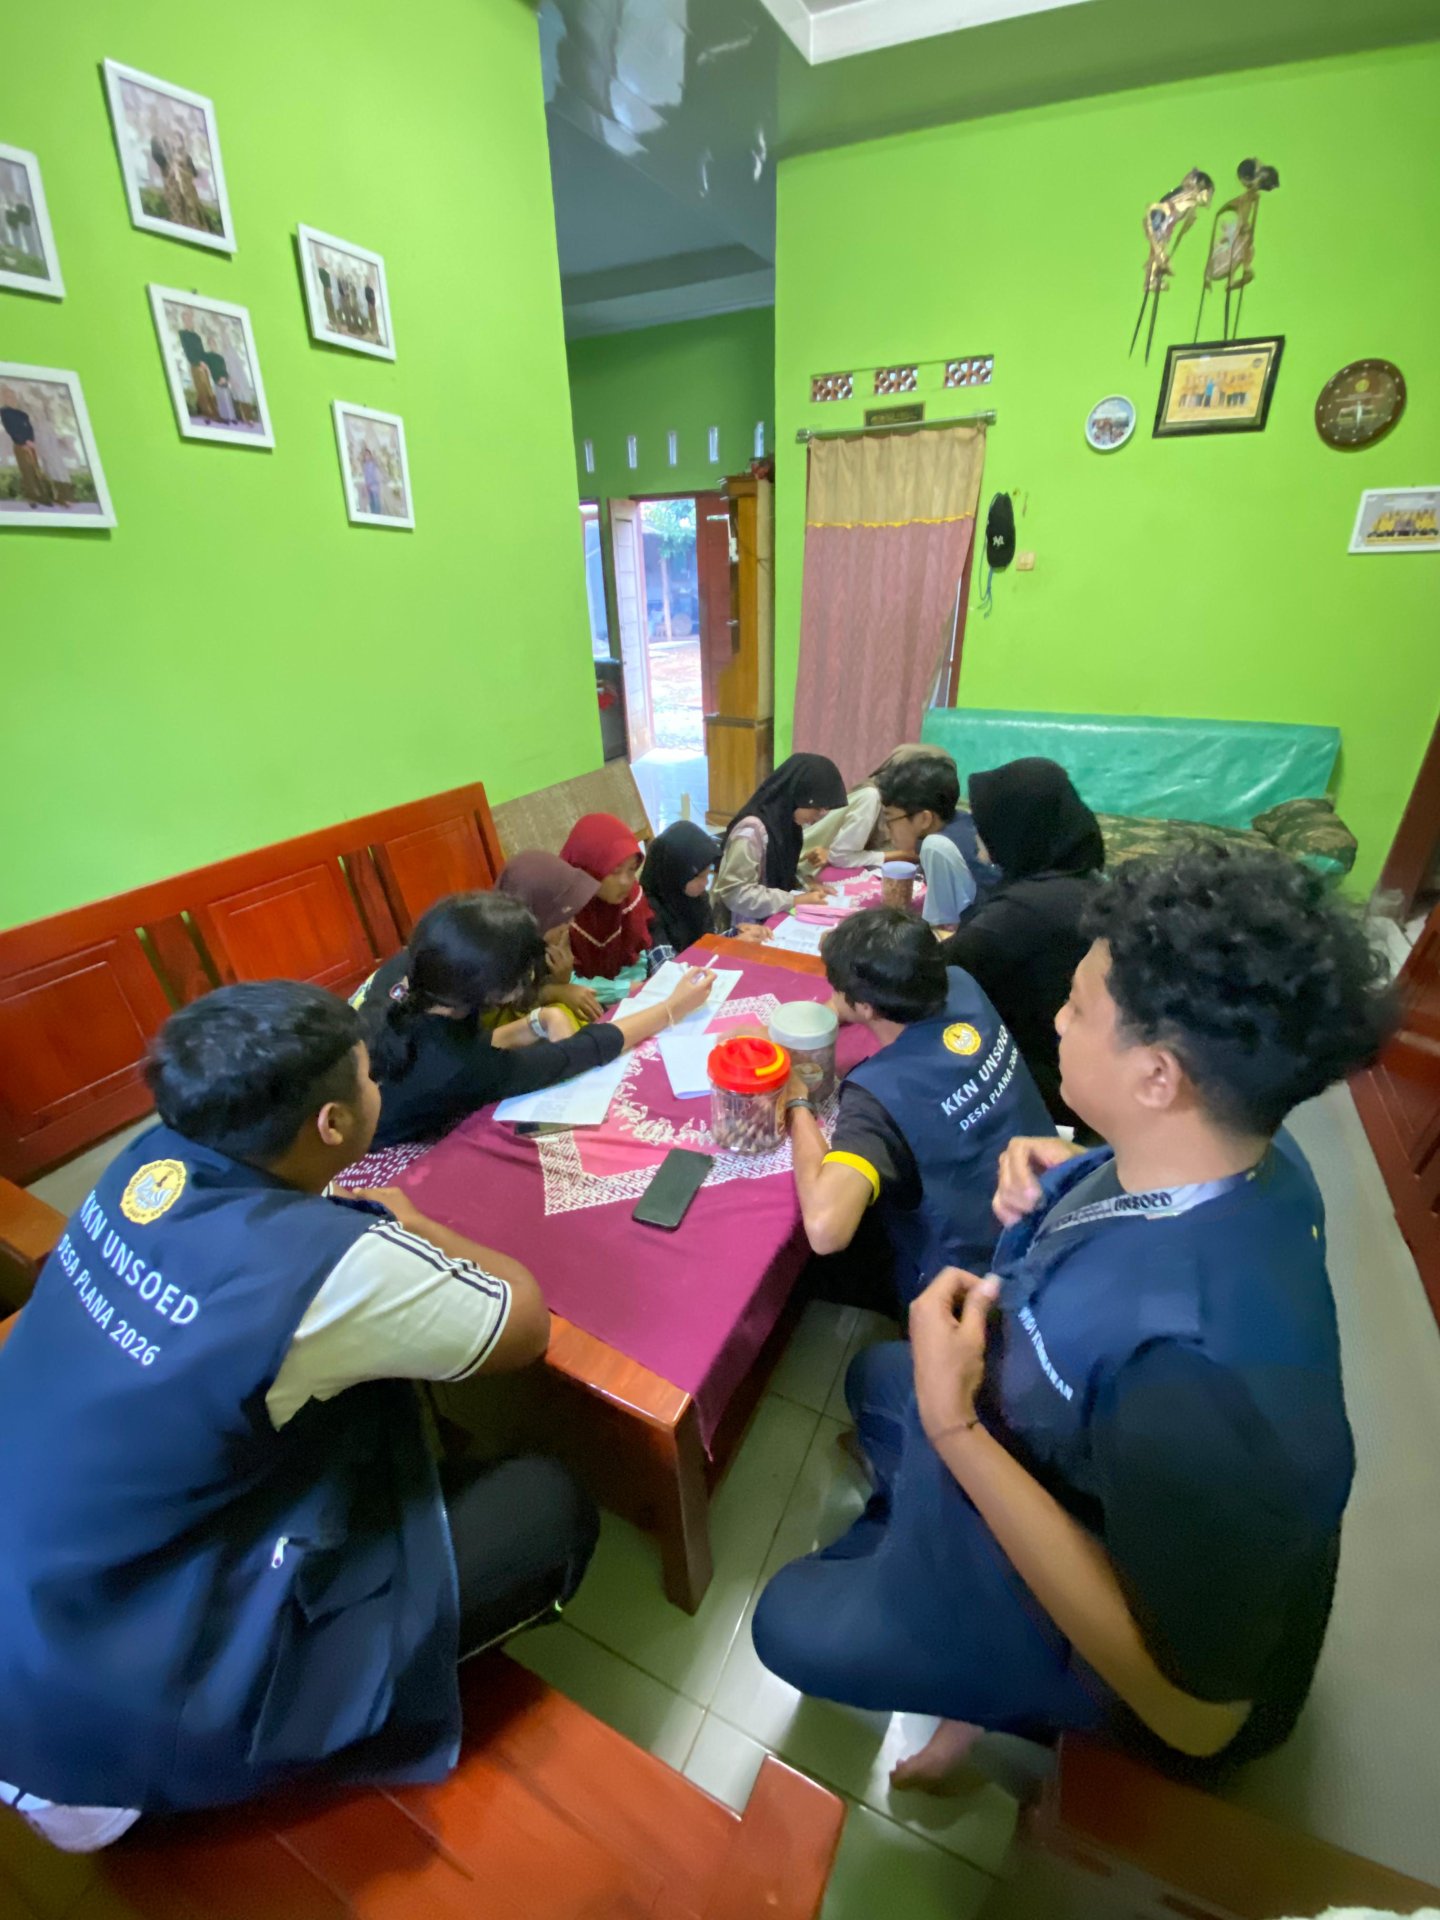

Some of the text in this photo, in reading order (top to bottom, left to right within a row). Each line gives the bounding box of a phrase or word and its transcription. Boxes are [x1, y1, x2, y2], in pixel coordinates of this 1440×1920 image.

[940, 1078, 979, 1116] KKN
[959, 1103, 991, 1132] DESA
[989, 1067, 1013, 1104] PLANA
[57, 1233, 161, 1366] DESA PLANA 2026
[80, 1189, 108, 1242] KKN
[102, 1229, 200, 1326] UNSOED
